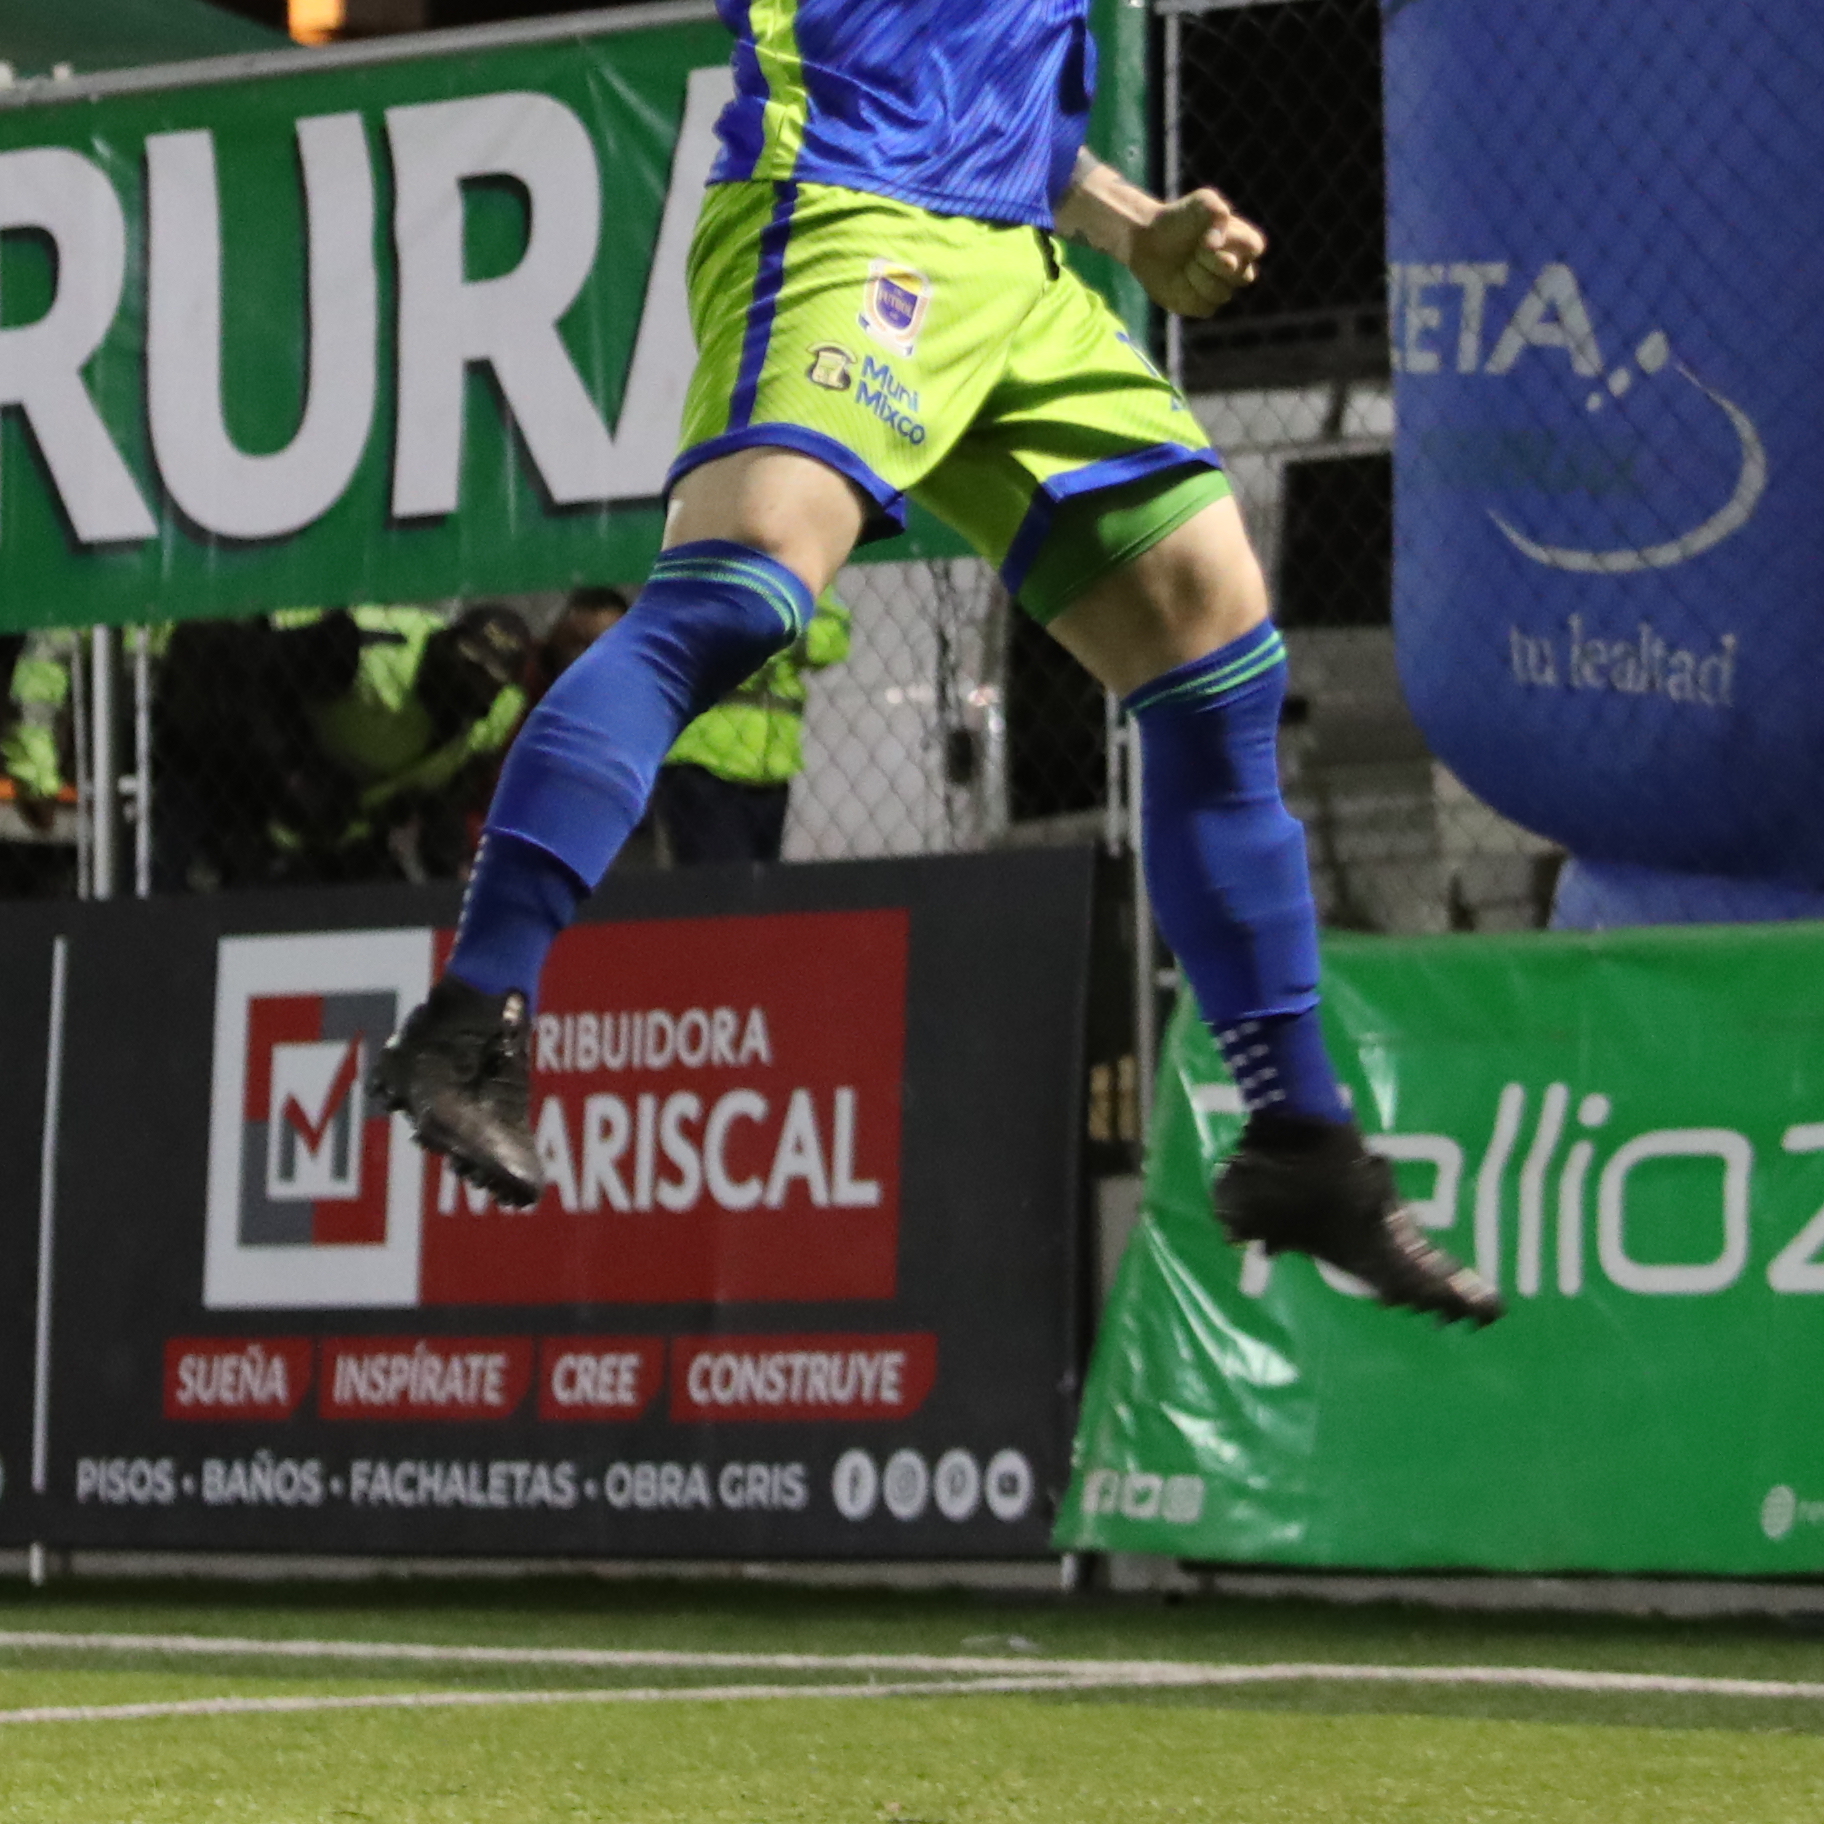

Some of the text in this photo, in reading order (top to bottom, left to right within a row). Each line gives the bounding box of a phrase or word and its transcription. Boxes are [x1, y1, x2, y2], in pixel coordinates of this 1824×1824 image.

[1387, 260, 1605, 377] ETA
[861, 354, 921, 413] Muni
[532, 1004, 773, 1074] RIBUIDORA
[175, 1340, 905, 1407] SUEÑA INSPÍRATE CREE CONSTRUYE
[76, 1447, 810, 1511] PISOS BAÑOS FACHALETAS OBRA GRIS
